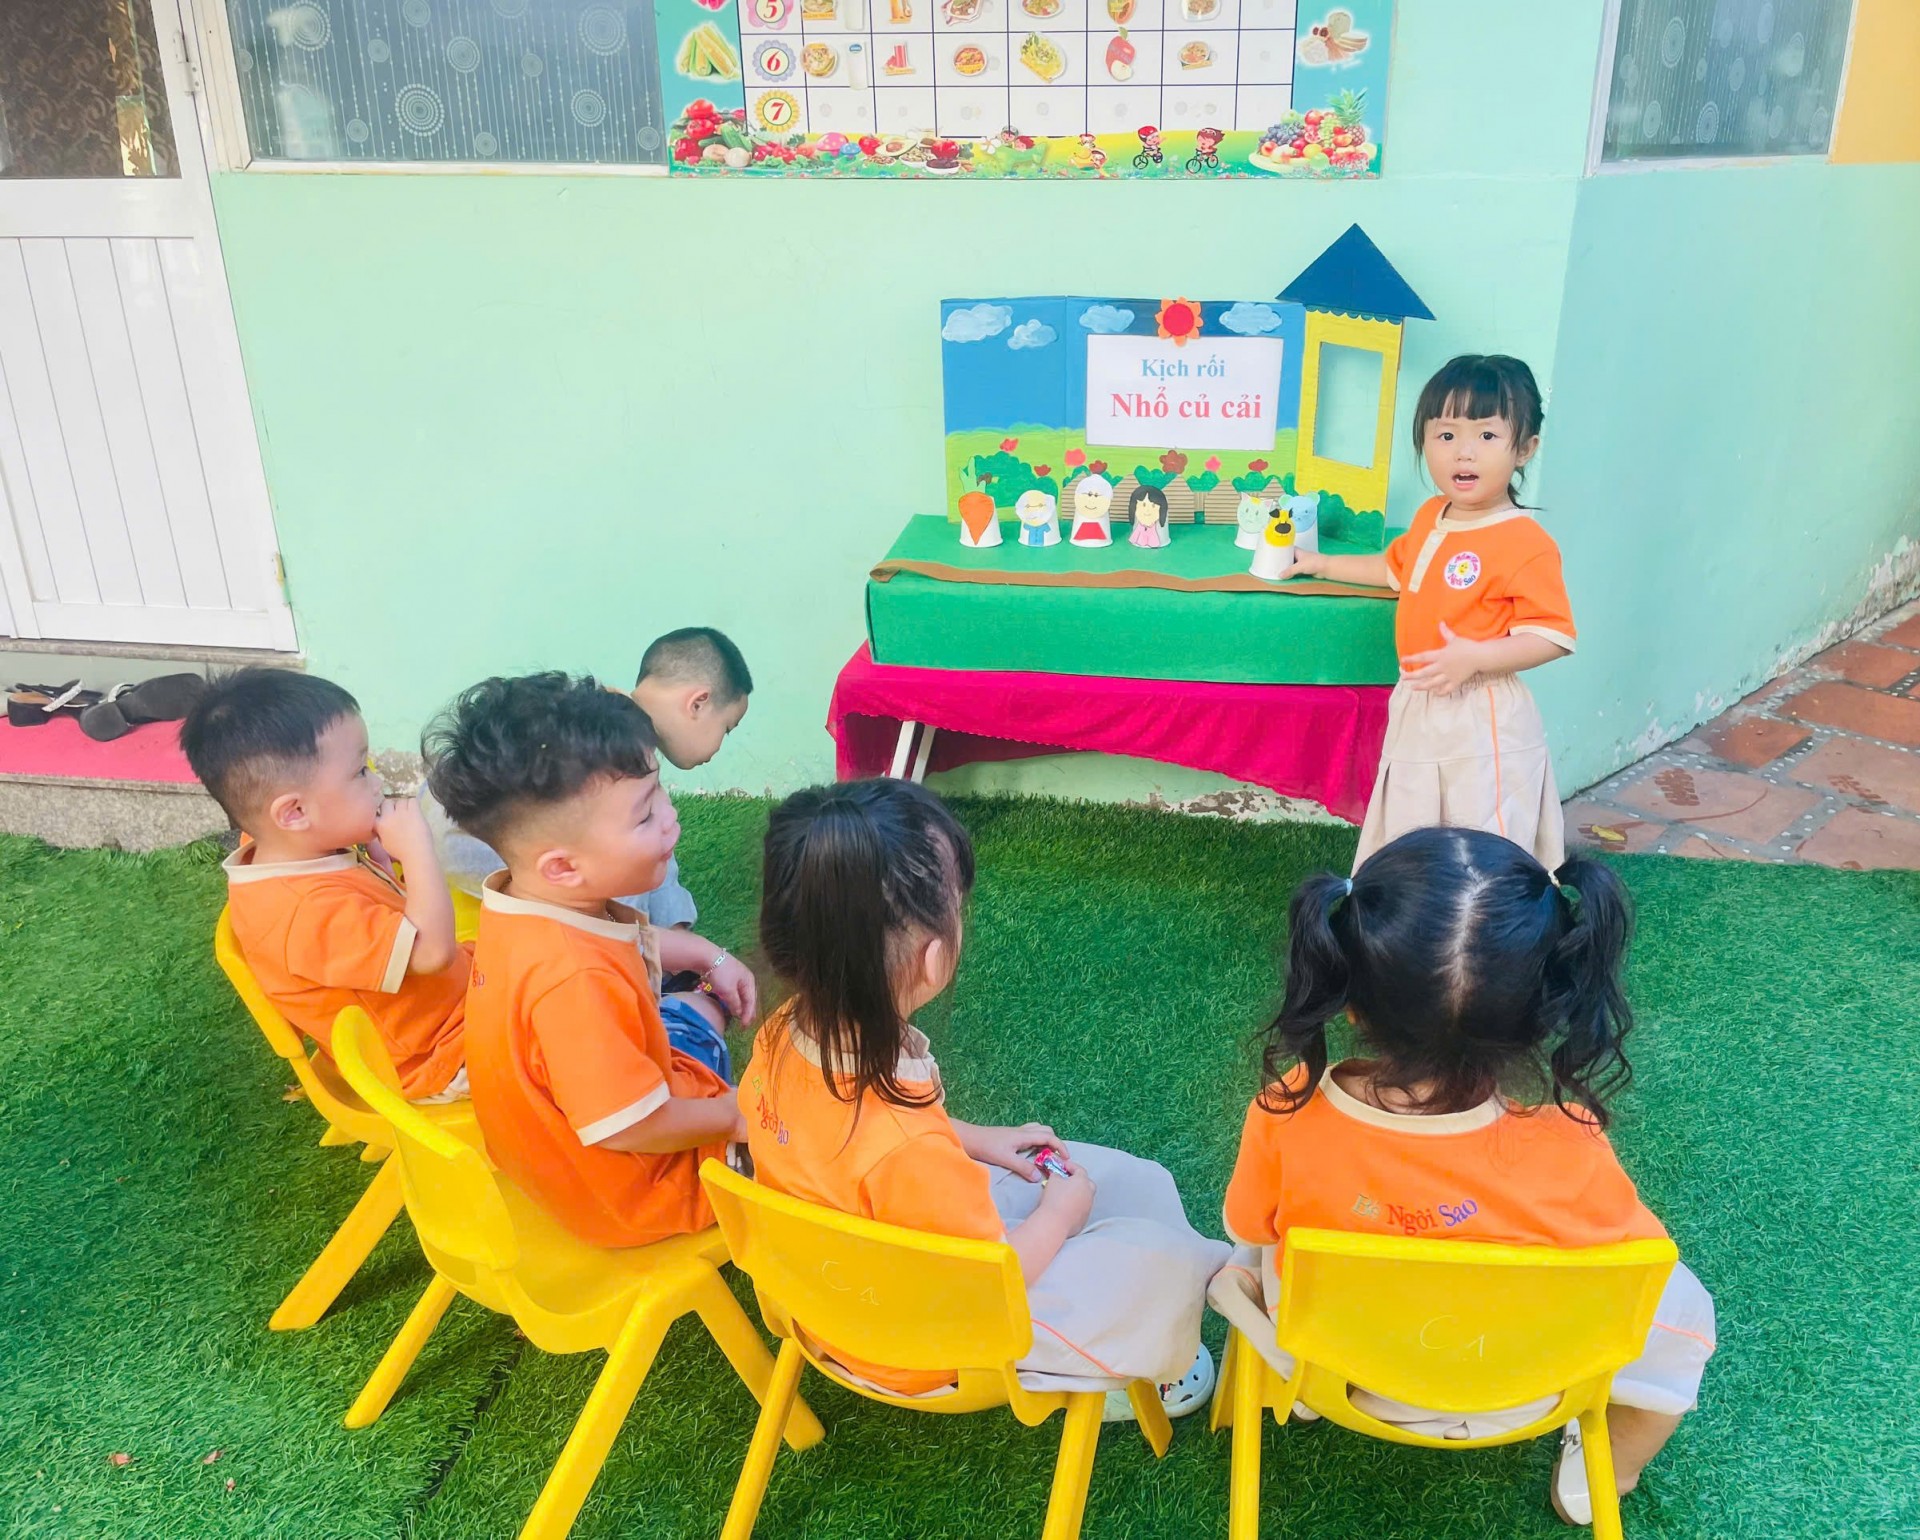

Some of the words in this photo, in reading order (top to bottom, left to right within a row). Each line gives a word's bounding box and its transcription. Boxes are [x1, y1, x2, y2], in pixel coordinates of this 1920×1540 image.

[763, 0, 778, 19] 5
[767, 51, 781, 72] 6
[771, 102, 785, 121] 7
[1141, 359, 1189, 381] Kịch
[1197, 354, 1226, 378] rối
[1110, 386, 1169, 418] Nhổ
[1178, 393, 1211, 418] củ
[1221, 394, 1262, 419] cải
[1385, 1203, 1438, 1236] Ngôi
[1438, 1199, 1478, 1227] Sao
